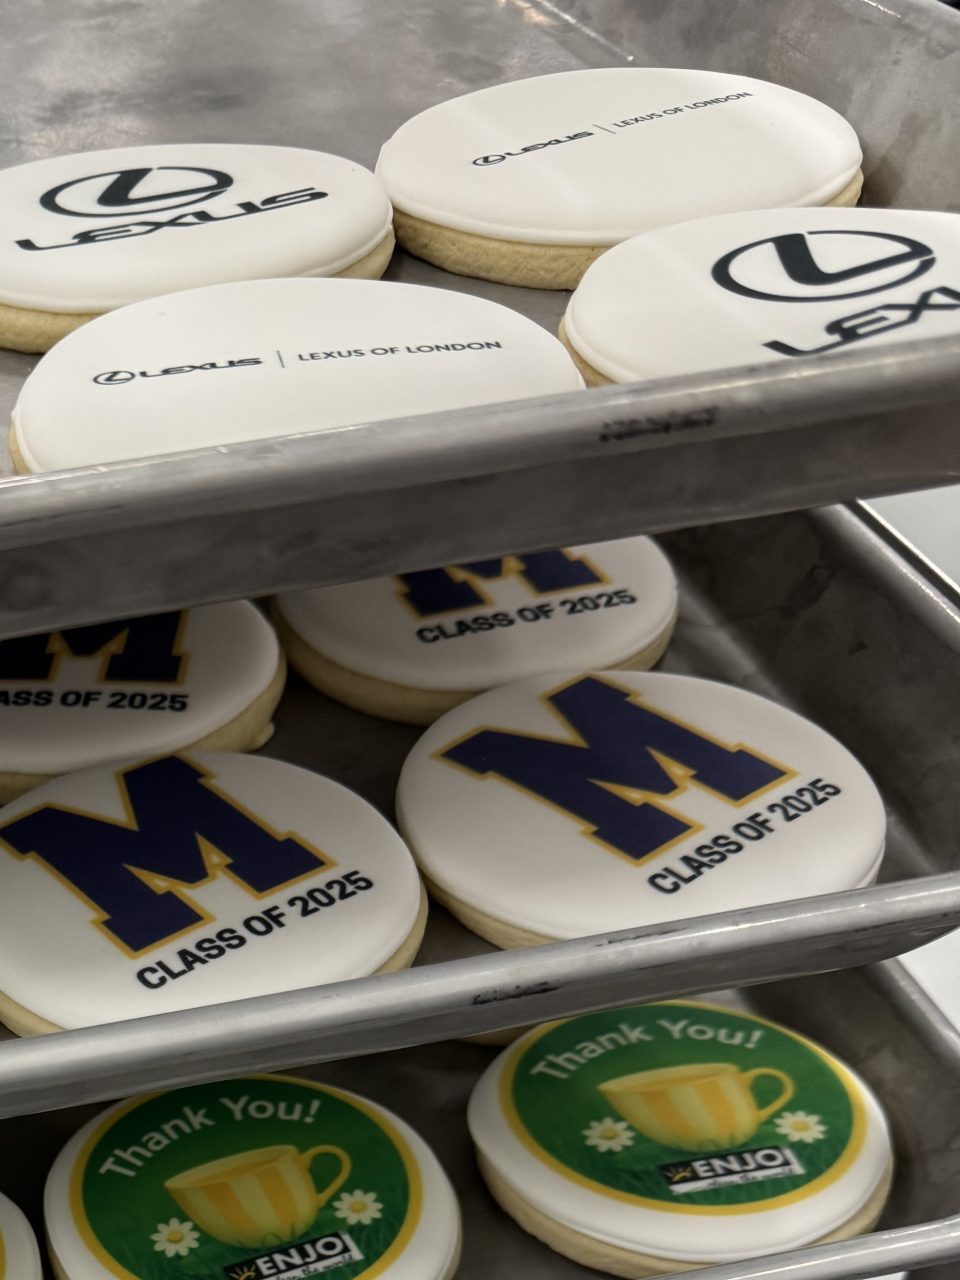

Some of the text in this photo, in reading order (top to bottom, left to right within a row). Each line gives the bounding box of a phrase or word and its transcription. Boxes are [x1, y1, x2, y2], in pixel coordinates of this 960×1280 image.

[504, 90, 753, 157] LEXUS LEXUS OF LONDON
[14, 186, 329, 251] LEXUS
[139, 341, 503, 378] LEXUS LEXUS OF LONDON
[415, 588, 638, 646] CLASS OF 2025
[59, 690, 103, 709] OF
[106, 691, 190, 713] 2025
[431, 672, 800, 868] M
[646, 777, 843, 897] CLASS OF 2025
[135, 869, 375, 991] CLASS OF 2025
[530, 1019, 765, 1079] Thank You!
[99, 1095, 321, 1178] Thank You!
[691, 1149, 783, 1177] ENJO
[256, 1237, 343, 1275] ENJO
